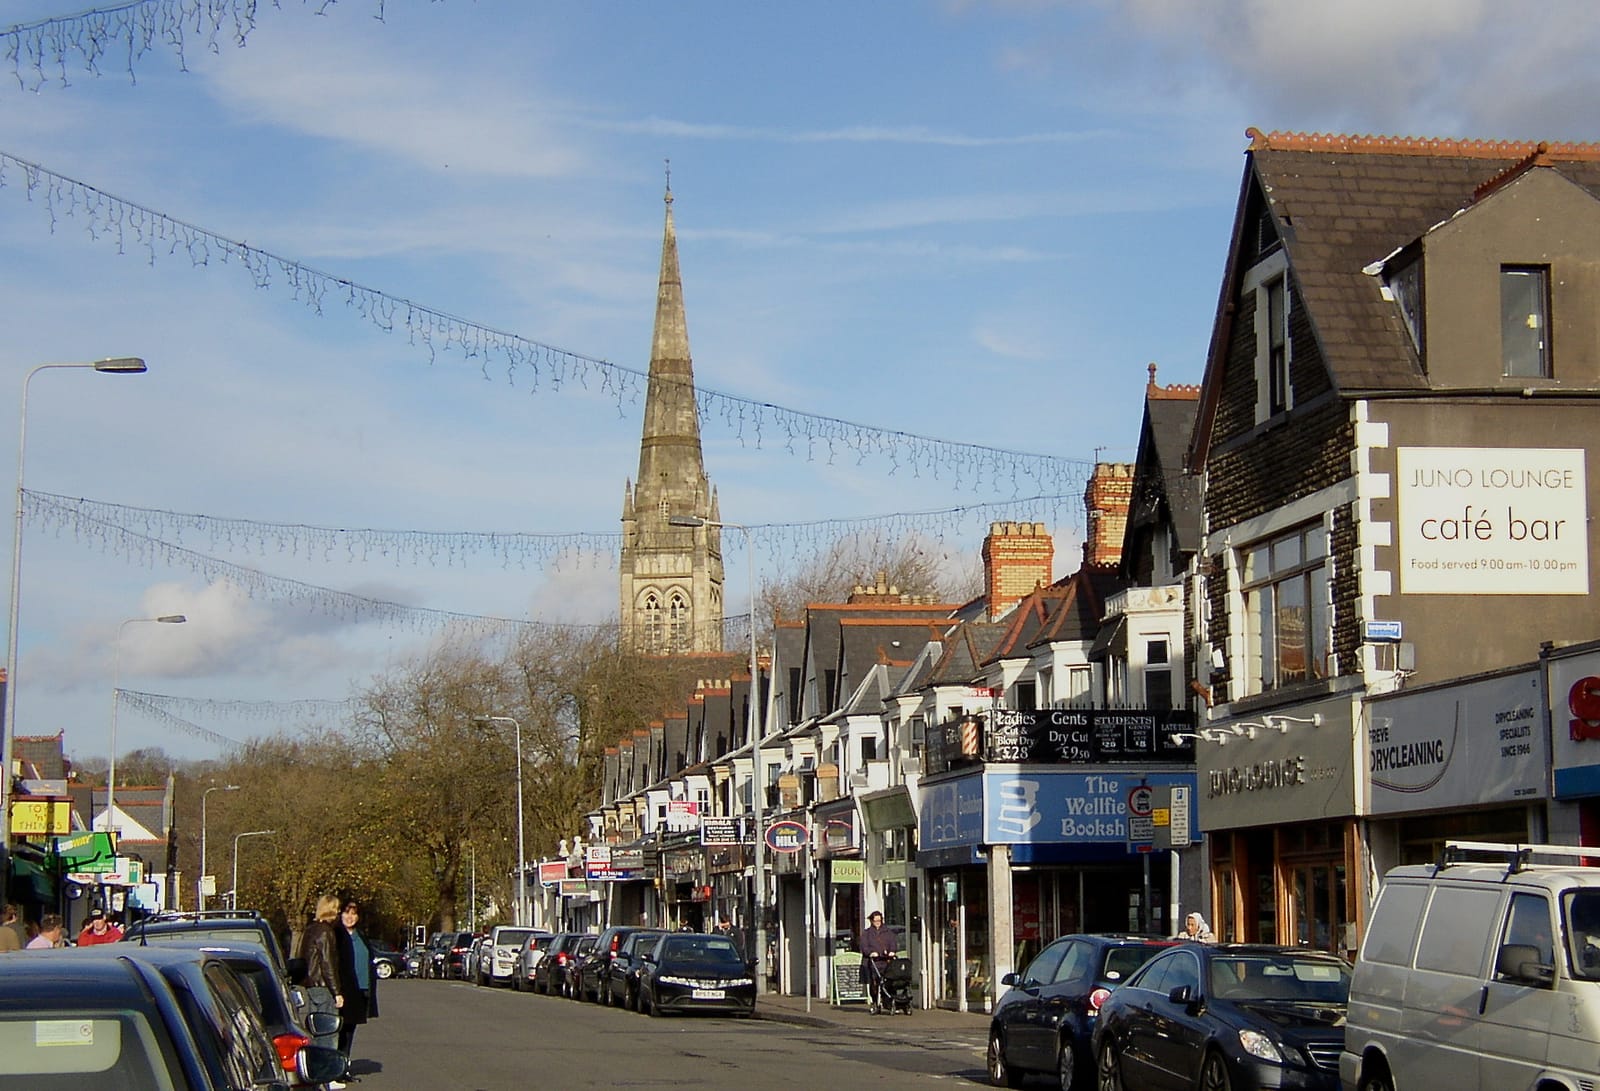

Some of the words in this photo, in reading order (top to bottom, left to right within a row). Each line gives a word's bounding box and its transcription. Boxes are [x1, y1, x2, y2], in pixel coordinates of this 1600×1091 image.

[1411, 468, 1473, 488] JUNO
[1481, 468, 1574, 489] LOUNGE
[1420, 505, 1492, 540] café
[1508, 505, 1566, 541] bar
[1411, 558, 1438, 569] Food
[1441, 558, 1478, 570] served
[997, 711, 1036, 725] Ladies
[1051, 711, 1088, 726] Gents
[1094, 716, 1152, 726] STUDENTS
[1495, 707, 1534, 724] DRYCLEANING
[1004, 726, 1019, 735] Cut
[1021, 726, 1028, 735] &
[1499, 725, 1531, 740] SPECIALISTS
[997, 735, 1018, 745] Blow
[1020, 735, 1034, 748] Dry
[1049, 731, 1069, 746] Dry
[1072, 731, 1089, 743] Cut
[1002, 746, 1029, 760] £28
[1501, 745, 1516, 757] SINCE
[1085, 776, 1118, 793] The
[1208, 768, 1241, 799] JUNO
[1246, 756, 1304, 791] LOUNGE
[1065, 797, 1126, 815] Wellfie
[19, 821, 63, 830] THINGS
[1061, 818, 1125, 836] Booksh
[775, 835, 799, 847] HILL
[833, 866, 861, 876] COOK
